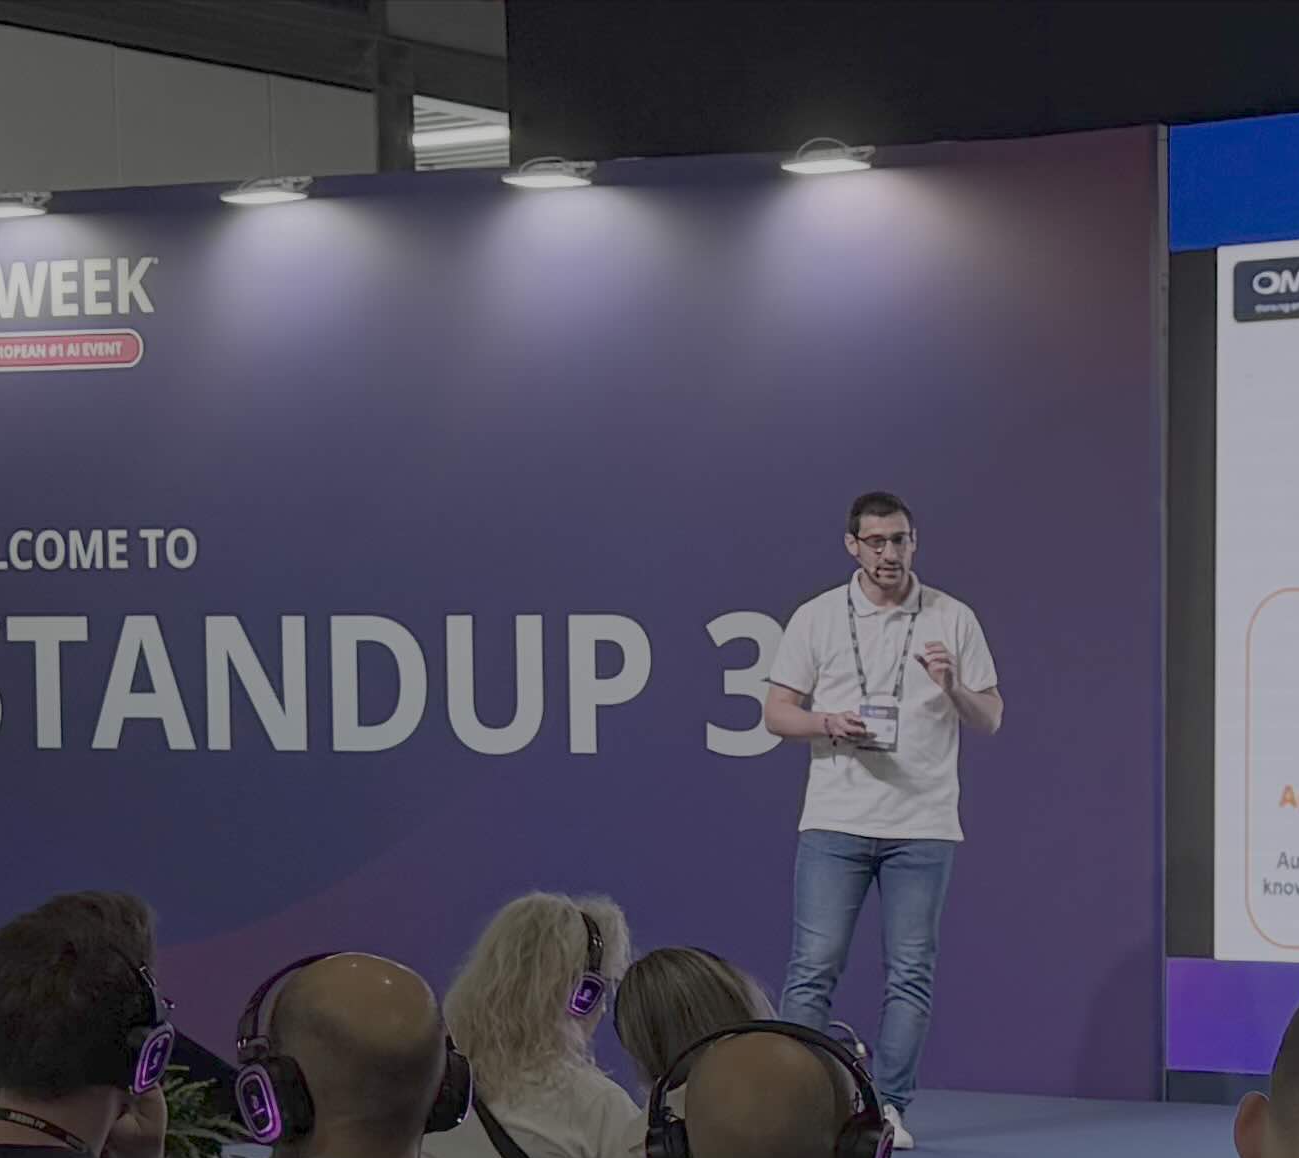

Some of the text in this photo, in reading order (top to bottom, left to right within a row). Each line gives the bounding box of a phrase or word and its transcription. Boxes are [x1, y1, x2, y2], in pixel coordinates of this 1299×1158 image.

[67, 344, 80, 357] AI
[82, 341, 123, 357] EVENT
[139, 528, 197, 568] TO
[706, 612, 784, 756] 3
